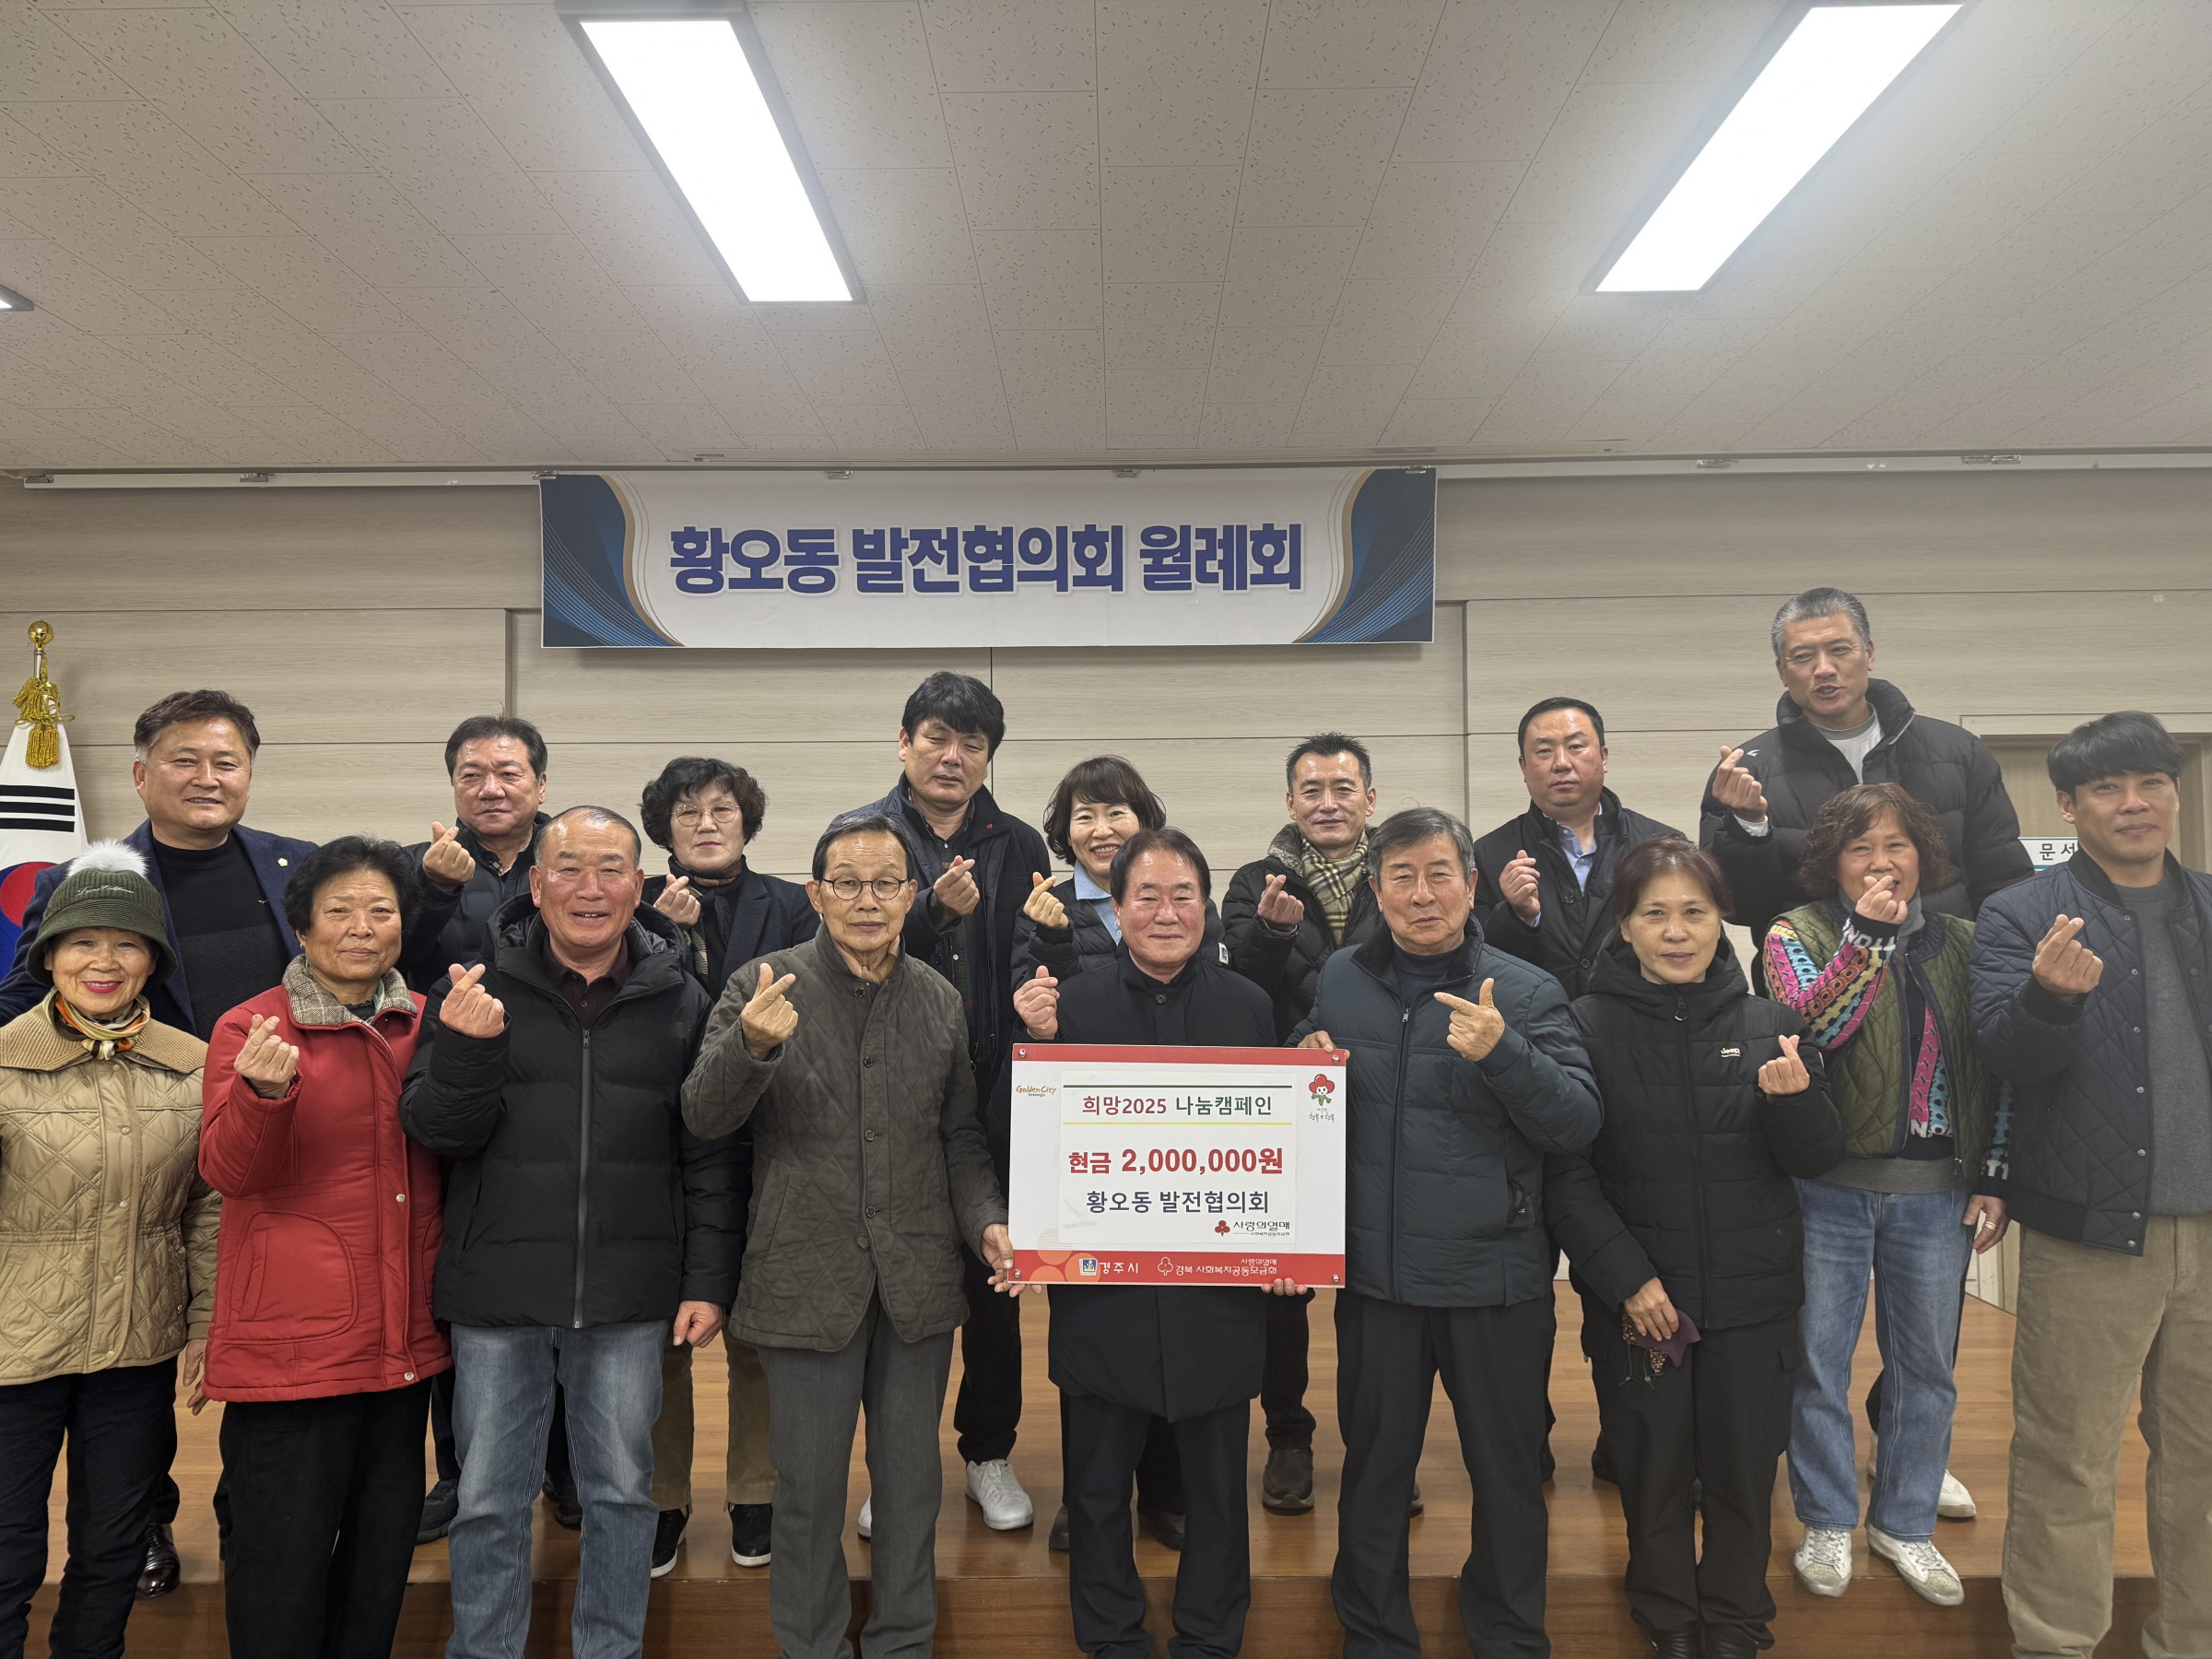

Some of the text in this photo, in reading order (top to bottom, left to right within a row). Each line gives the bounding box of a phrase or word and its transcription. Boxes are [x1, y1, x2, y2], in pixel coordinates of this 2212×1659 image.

[670, 524, 1300, 594] 황오동 발전협의회 월레회
[1016, 1085, 1057, 1096] Golden City
[1082, 1096, 1272, 1116] 희망2025 나눔캠페인
[1068, 1147, 1283, 1175] 현금 2,000,000원
[1086, 1191, 1268, 1214] 황오동 발전협의회
[1233, 1221, 1289, 1231] 사랑의열매
